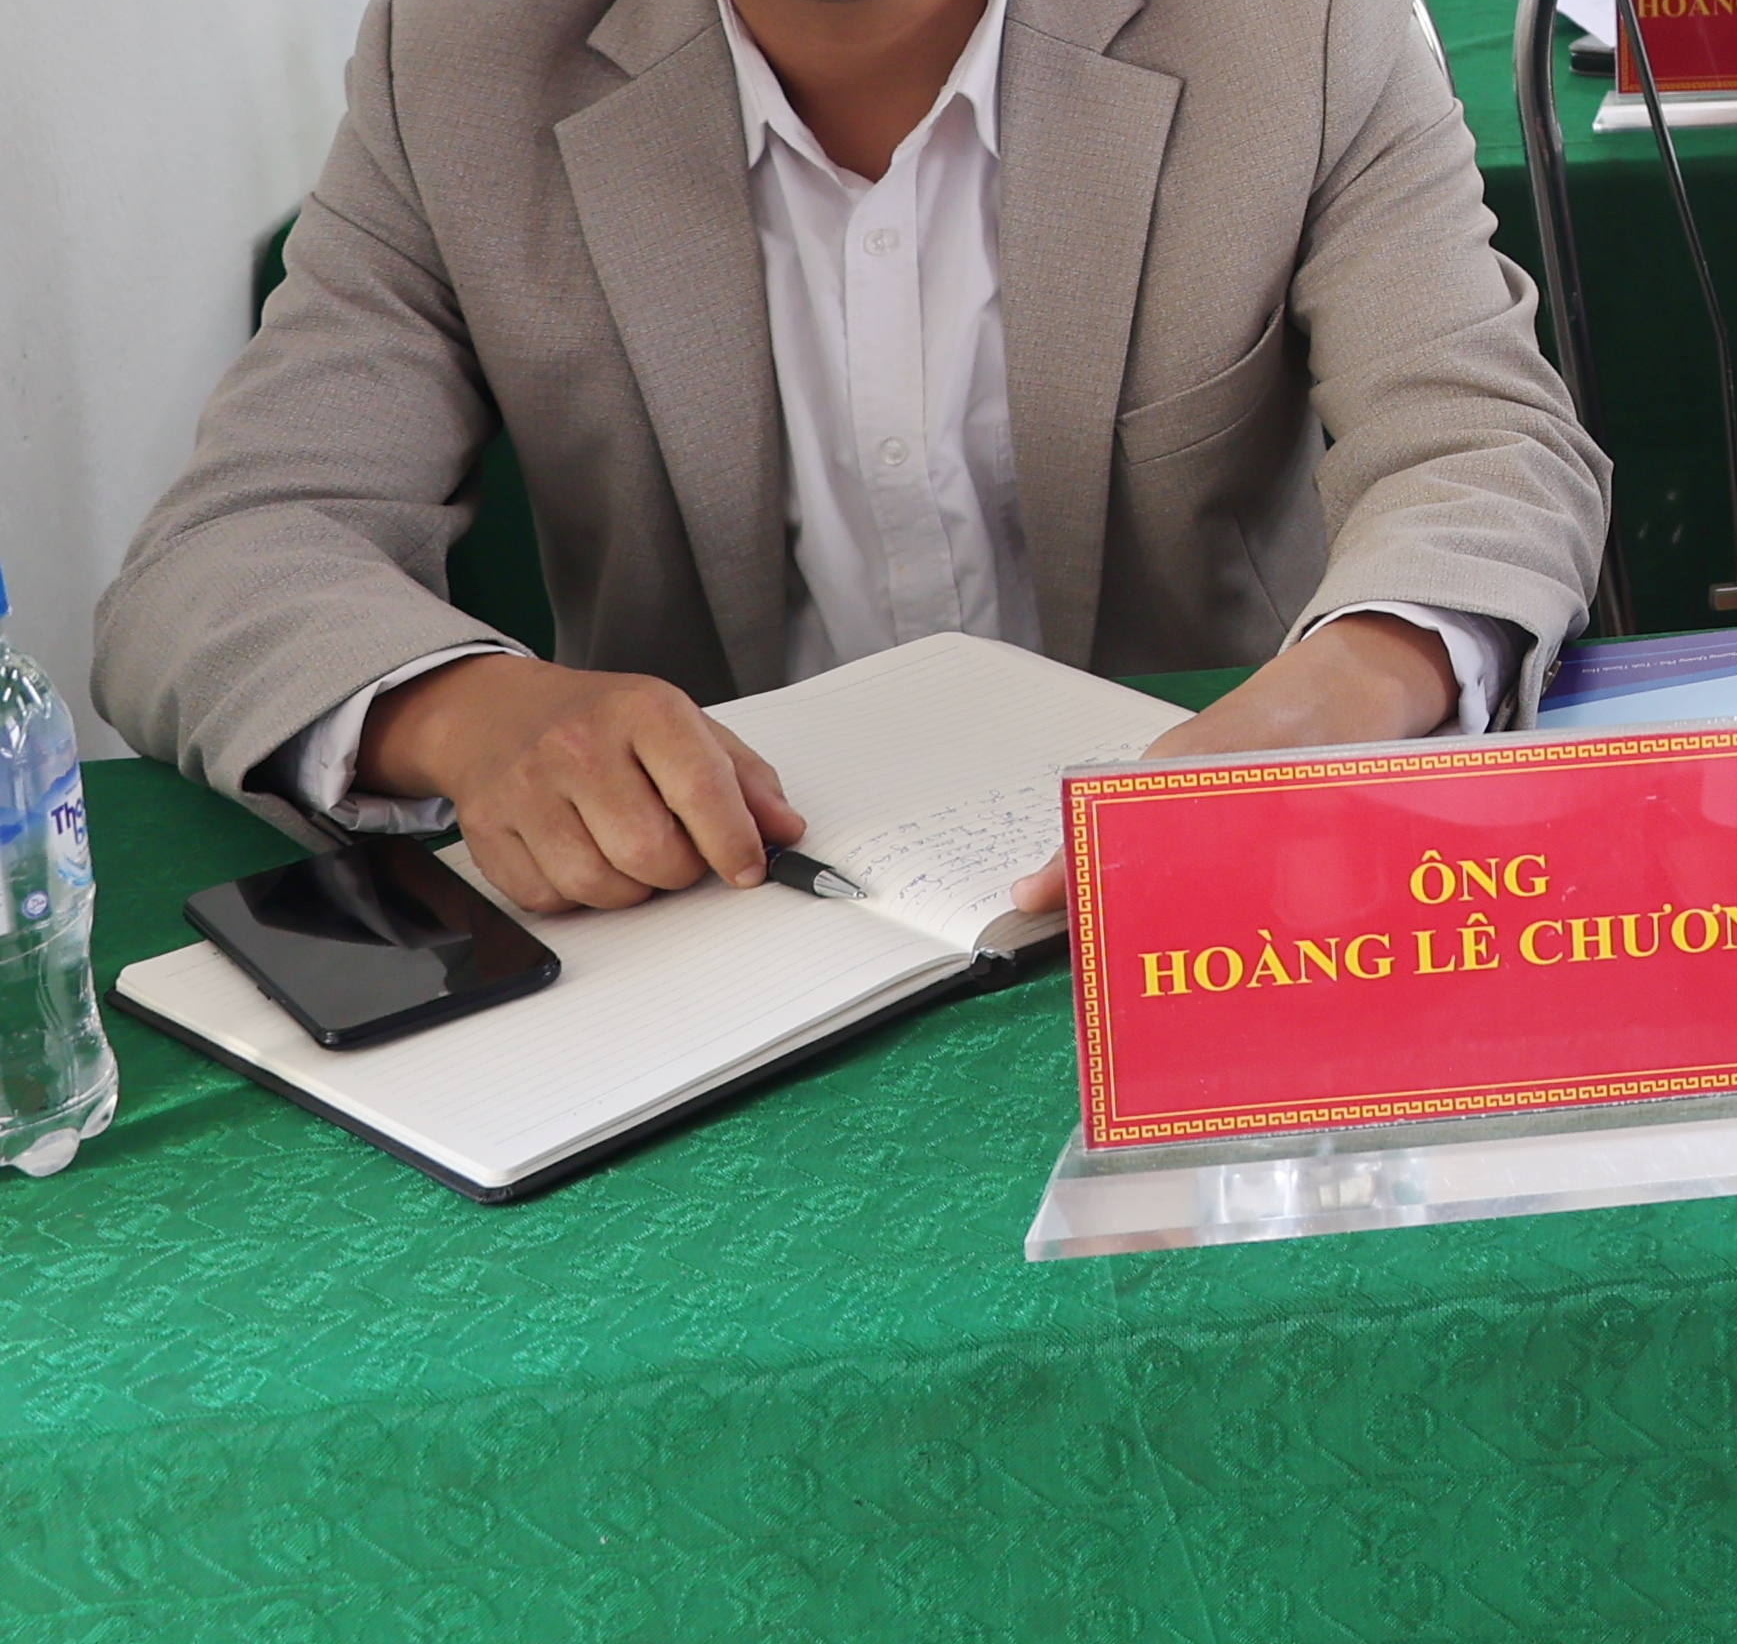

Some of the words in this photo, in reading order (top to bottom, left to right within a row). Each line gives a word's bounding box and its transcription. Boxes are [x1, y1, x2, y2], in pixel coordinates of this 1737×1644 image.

[1410, 849, 1549, 905] ÔNG
[1140, 930, 1394, 998] HOÀNG
[1413, 914, 1501, 976] LÊ
